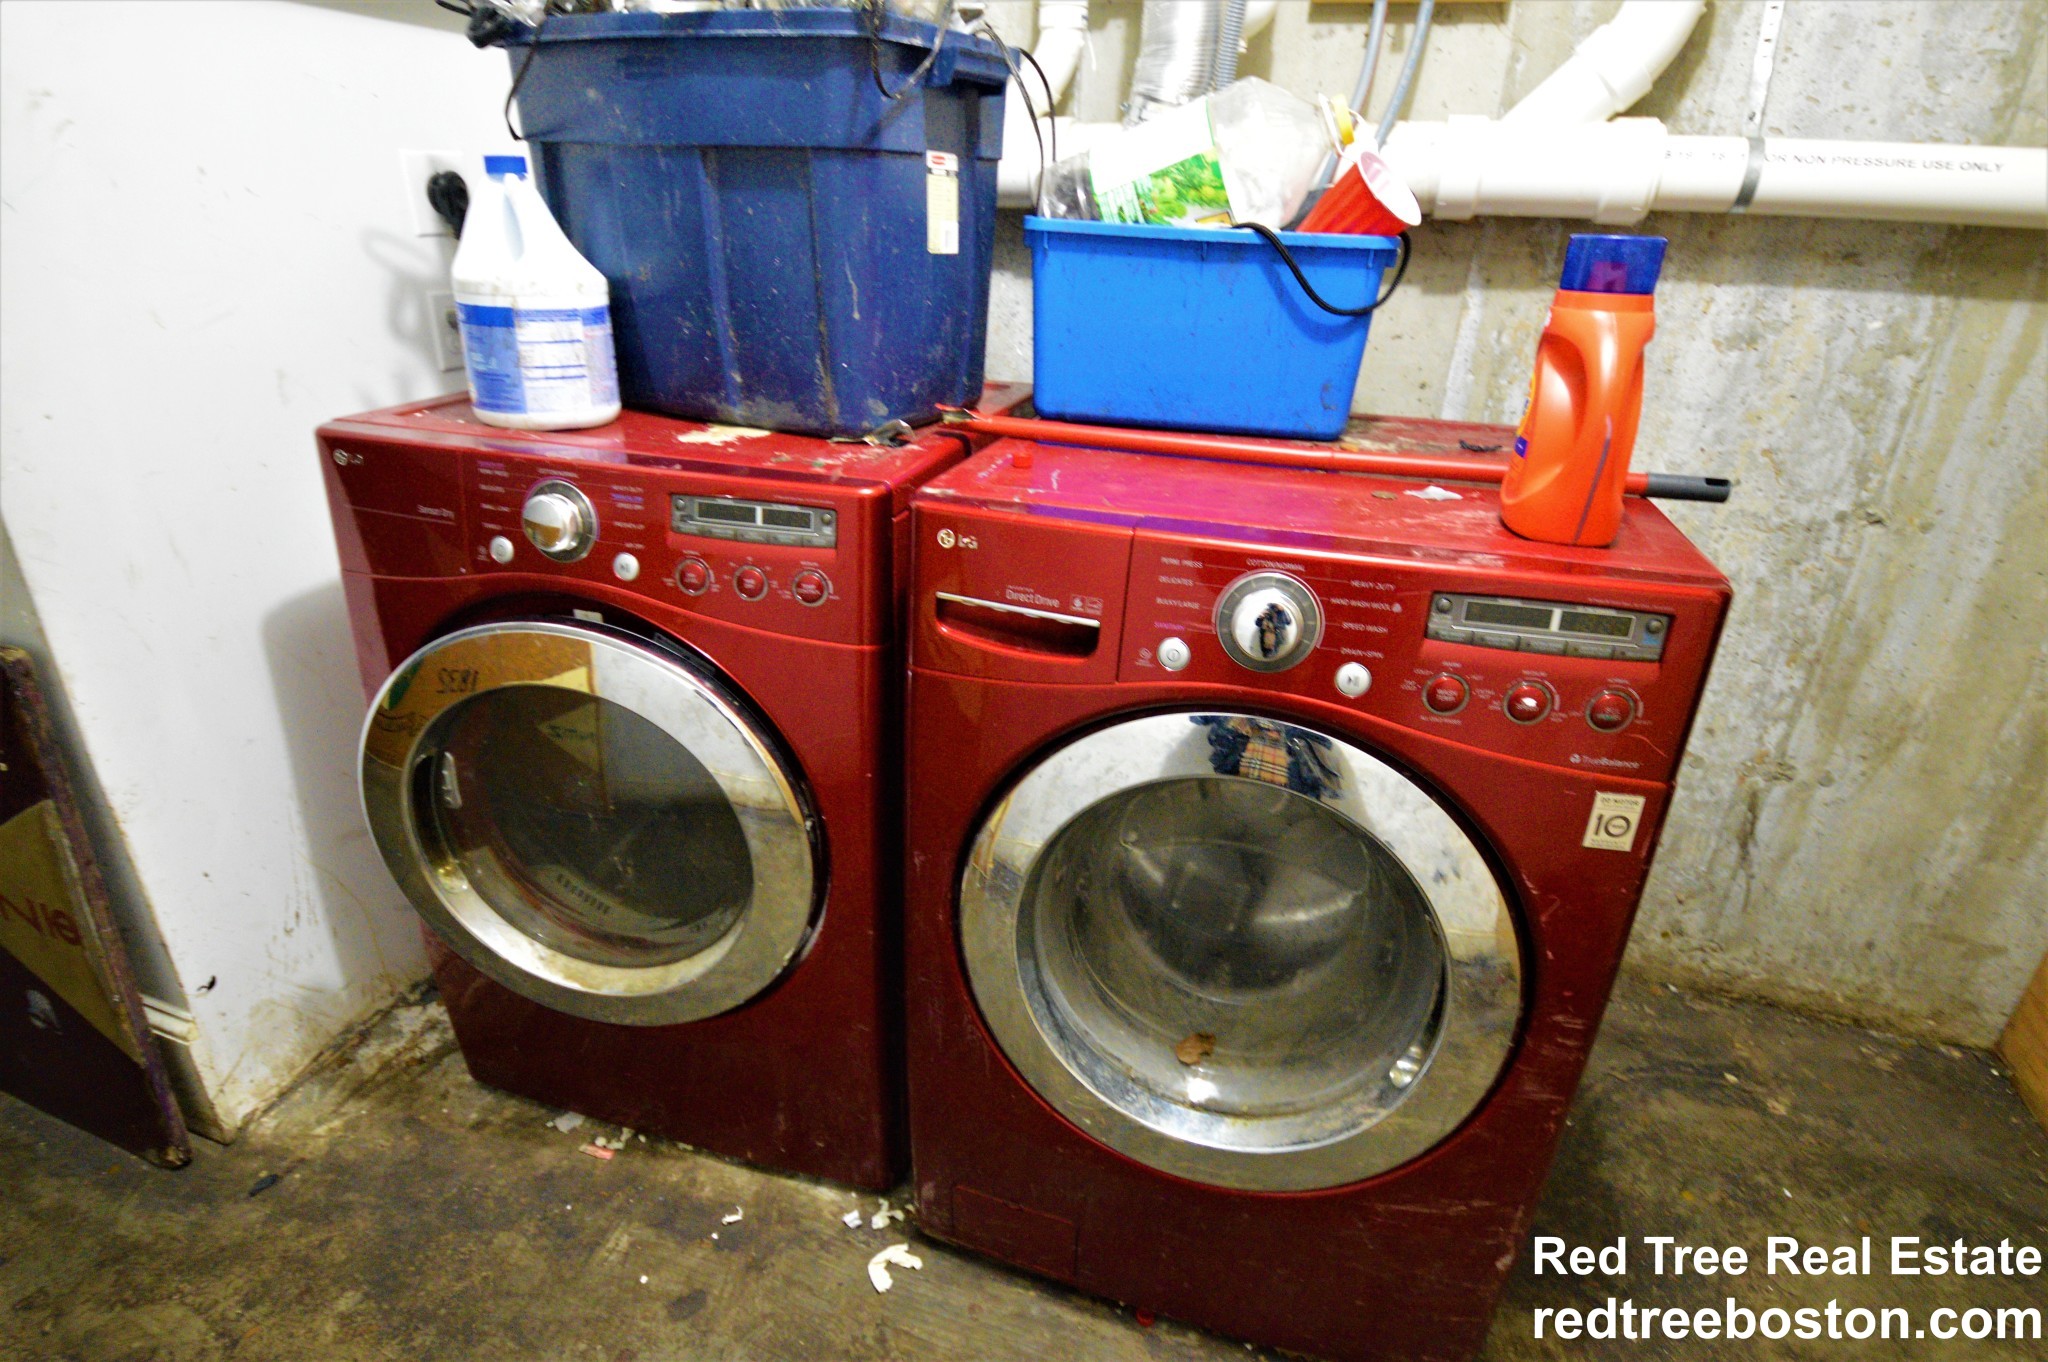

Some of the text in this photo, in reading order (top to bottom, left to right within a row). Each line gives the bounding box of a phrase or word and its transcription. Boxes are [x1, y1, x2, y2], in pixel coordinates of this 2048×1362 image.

[1793, 153, 1825, 165] NON
[1832, 155, 1917, 169] PRESSURE
[1922, 160, 1954, 171] USE
[1959, 161, 2004, 173] ONLY
[1006, 588, 1034, 601] Direct
[1034, 593, 1060, 608] Drive
